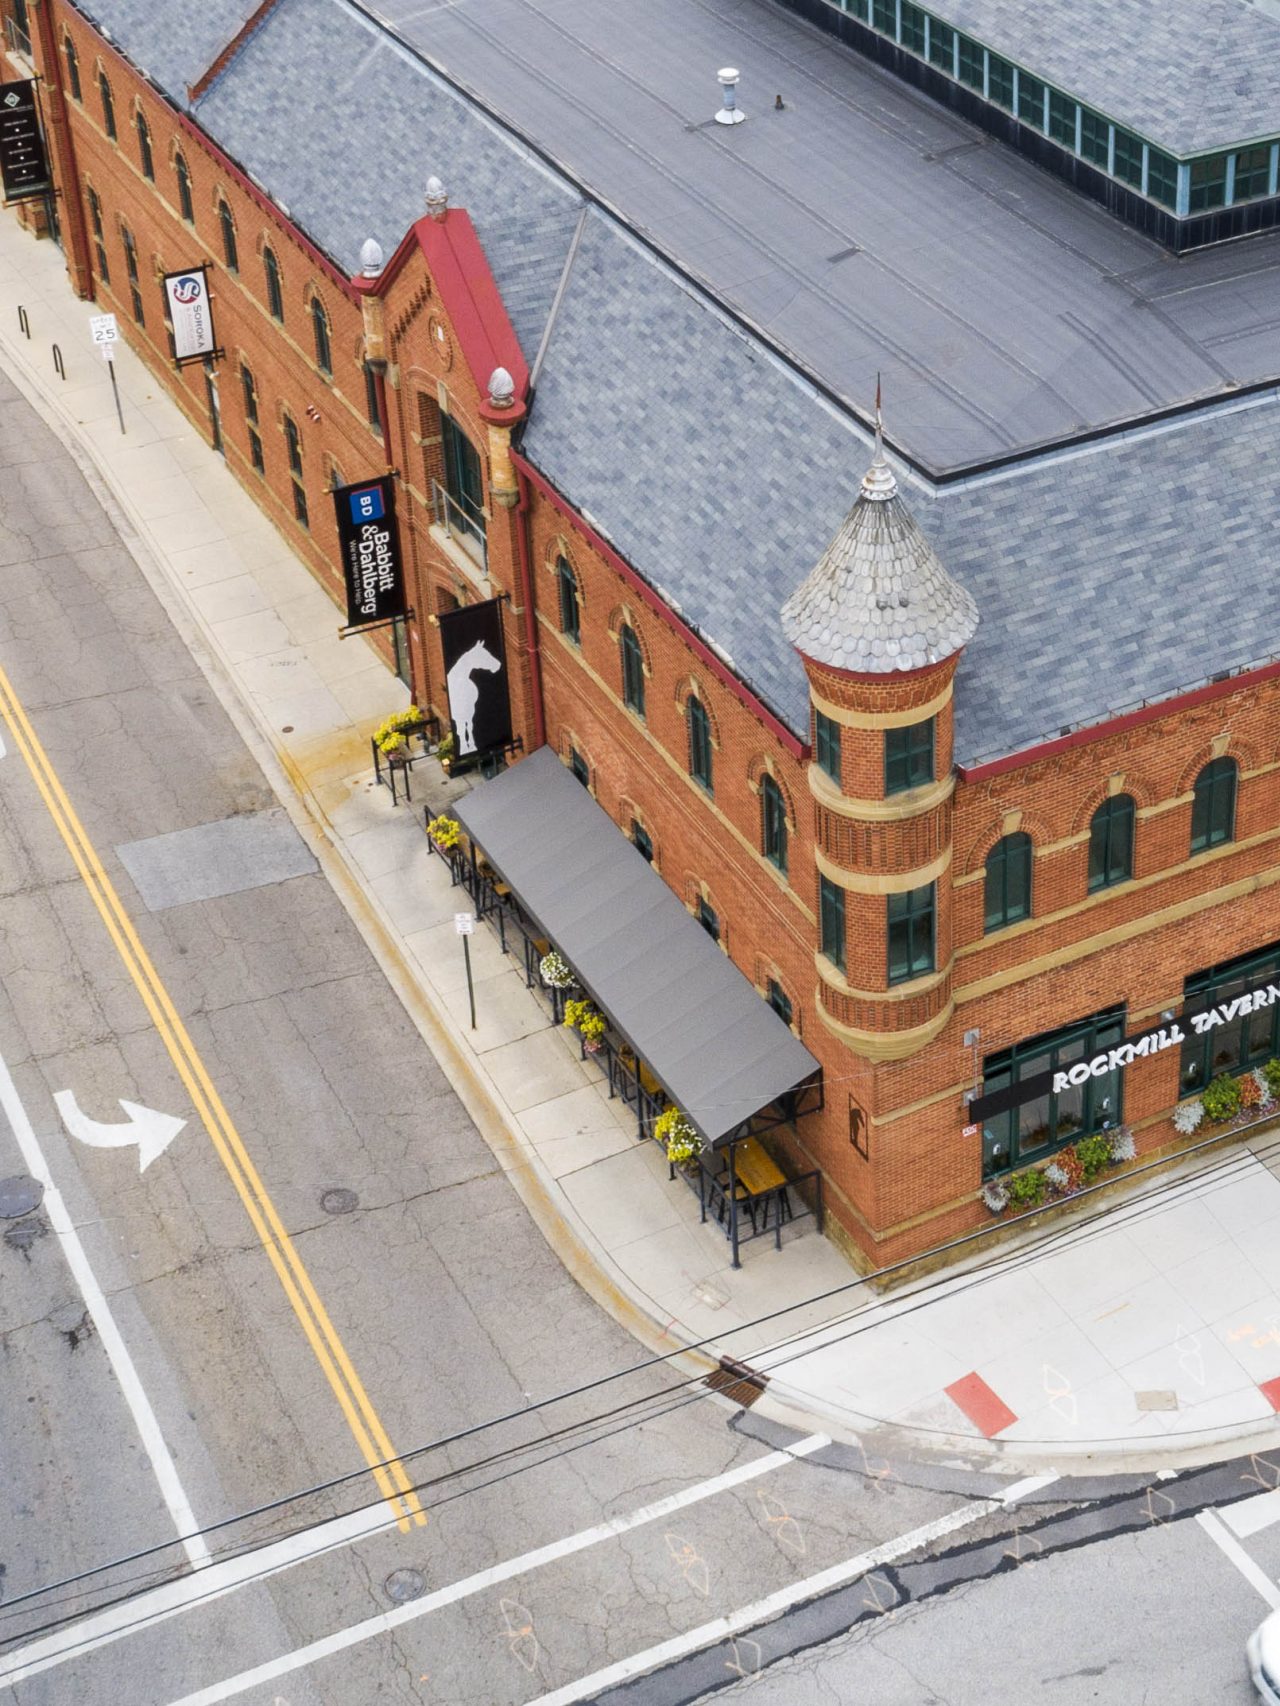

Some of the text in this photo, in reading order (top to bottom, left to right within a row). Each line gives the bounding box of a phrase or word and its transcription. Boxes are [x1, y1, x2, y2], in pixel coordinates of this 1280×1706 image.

[95, 328, 115, 341] 25
[193, 304, 205, 348] SOROKA
[359, 540, 377, 614] Dahlberg
[374, 531, 394, 592] Babbitt
[1052, 1024, 1185, 1094] ROCKMILL
